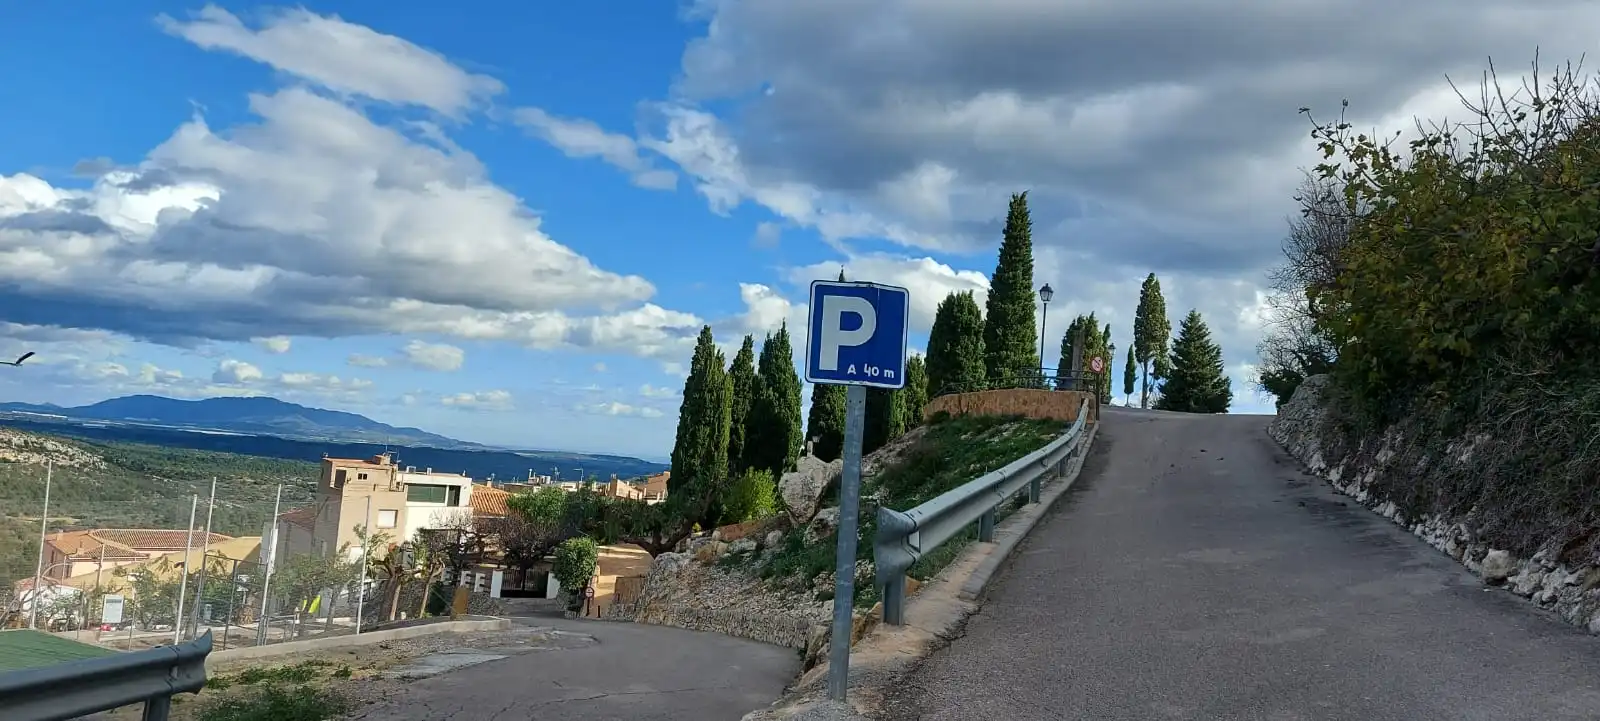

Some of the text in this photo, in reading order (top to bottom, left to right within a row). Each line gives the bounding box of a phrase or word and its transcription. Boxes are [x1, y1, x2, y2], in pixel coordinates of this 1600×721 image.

[819, 295, 877, 370] P
[847, 363, 895, 379] A 40 m
